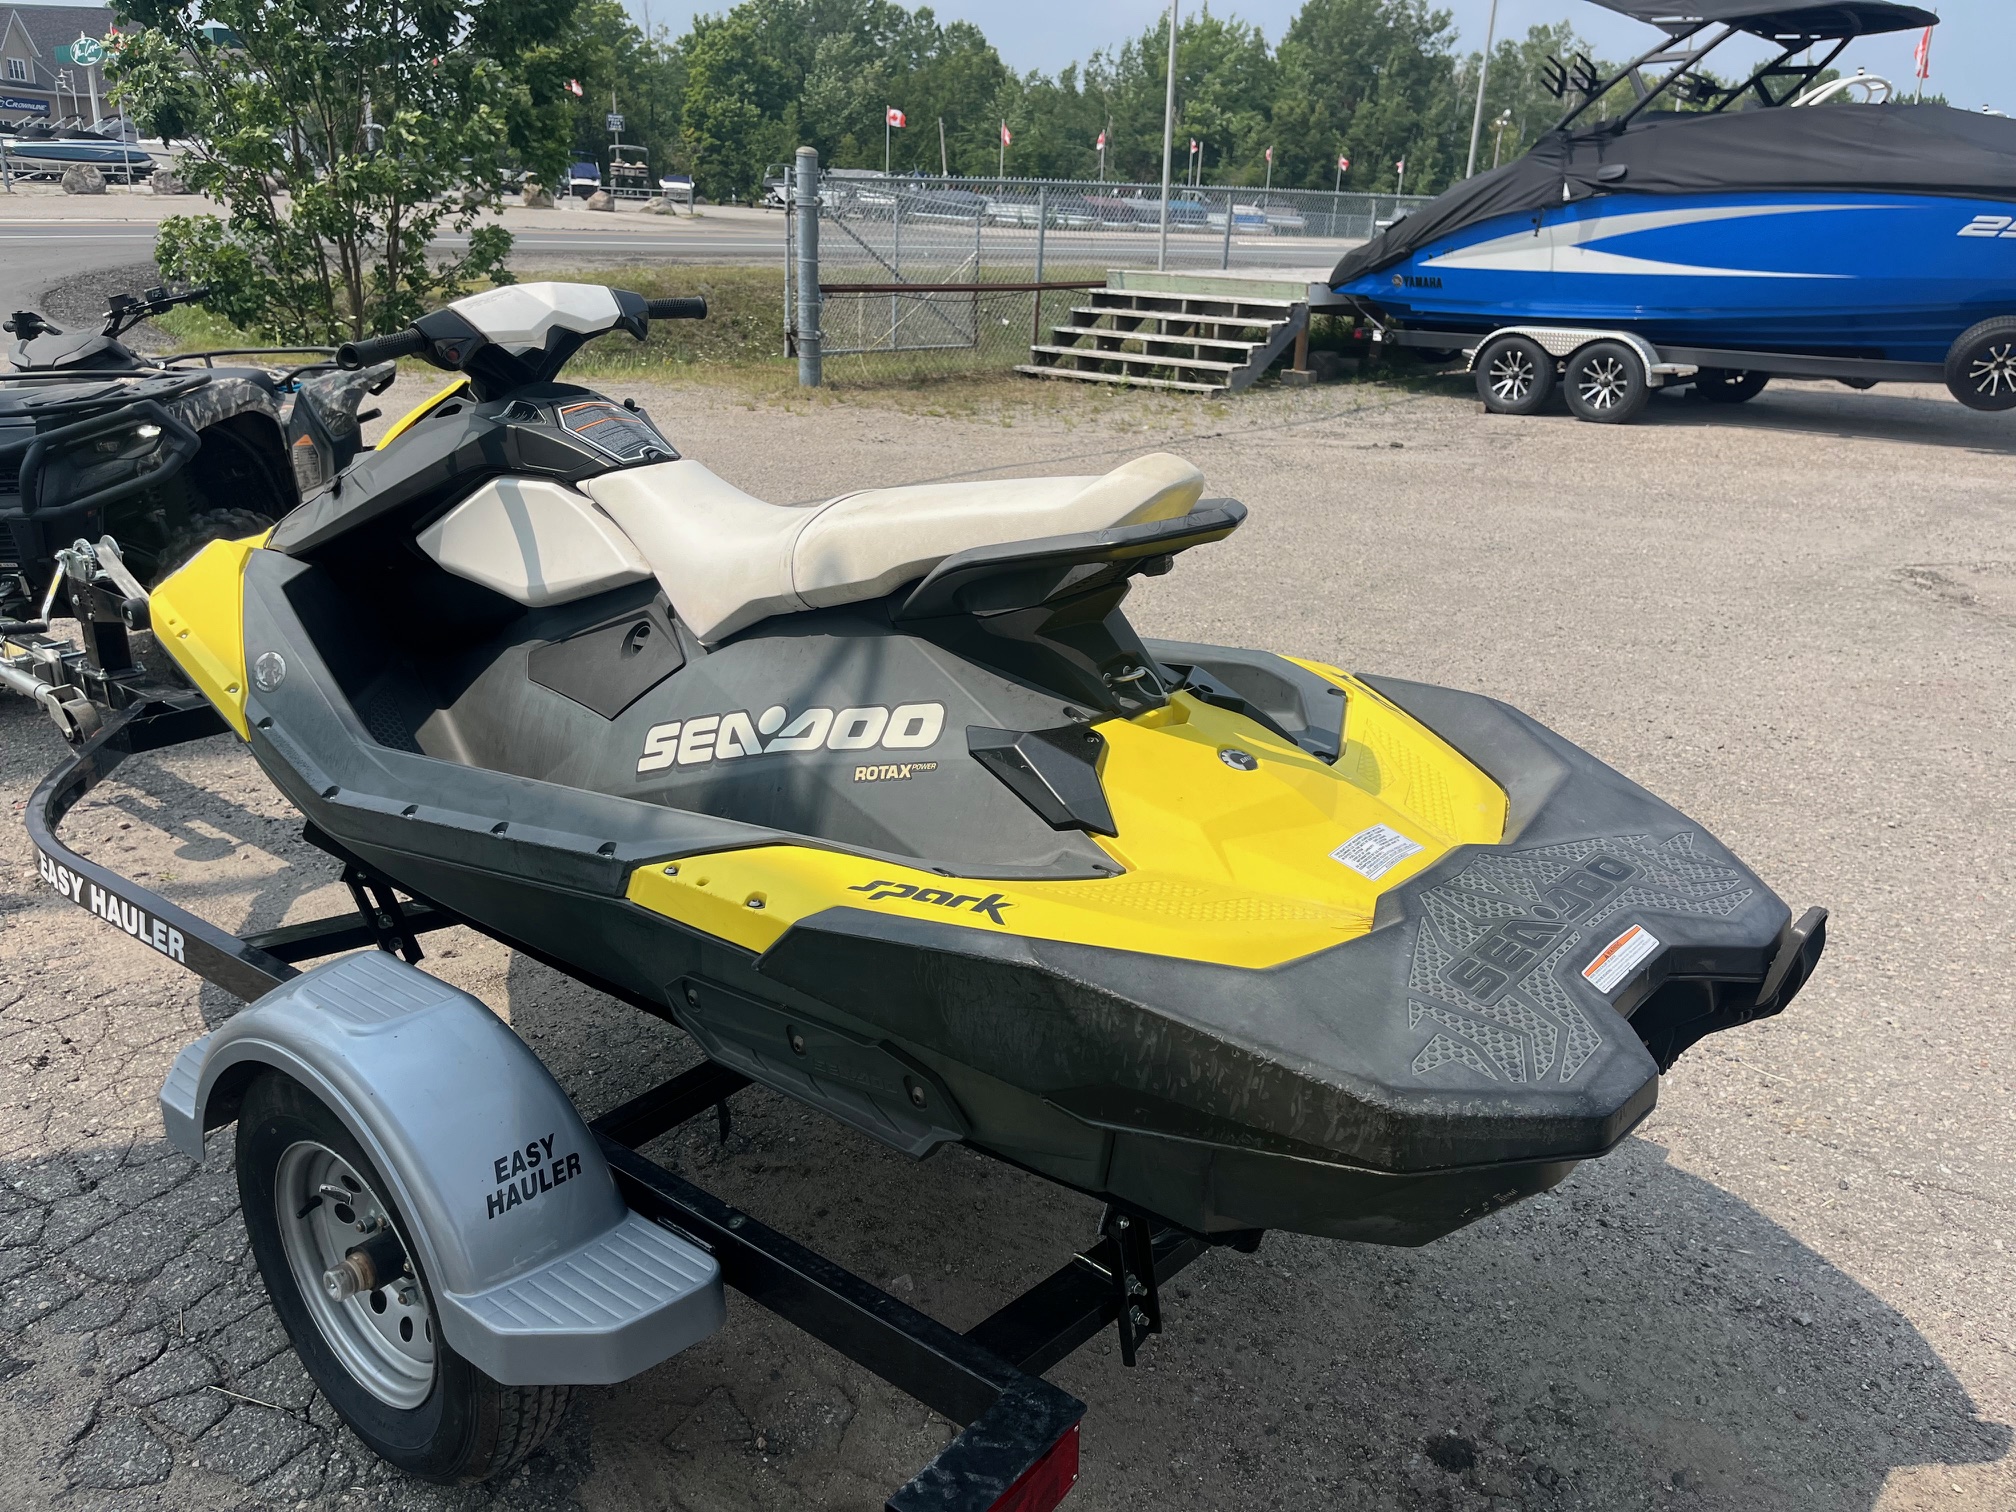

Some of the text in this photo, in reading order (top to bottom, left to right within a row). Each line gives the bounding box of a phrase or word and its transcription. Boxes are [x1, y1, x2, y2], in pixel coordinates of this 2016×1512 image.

[1404, 276, 1443, 289] YAMAHA
[854, 762, 937, 781] ROTAX POWER
[38, 849, 186, 963] EASY HAULER
[494, 1133, 554, 1184] EASY
[486, 1152, 582, 1220] HAULER
